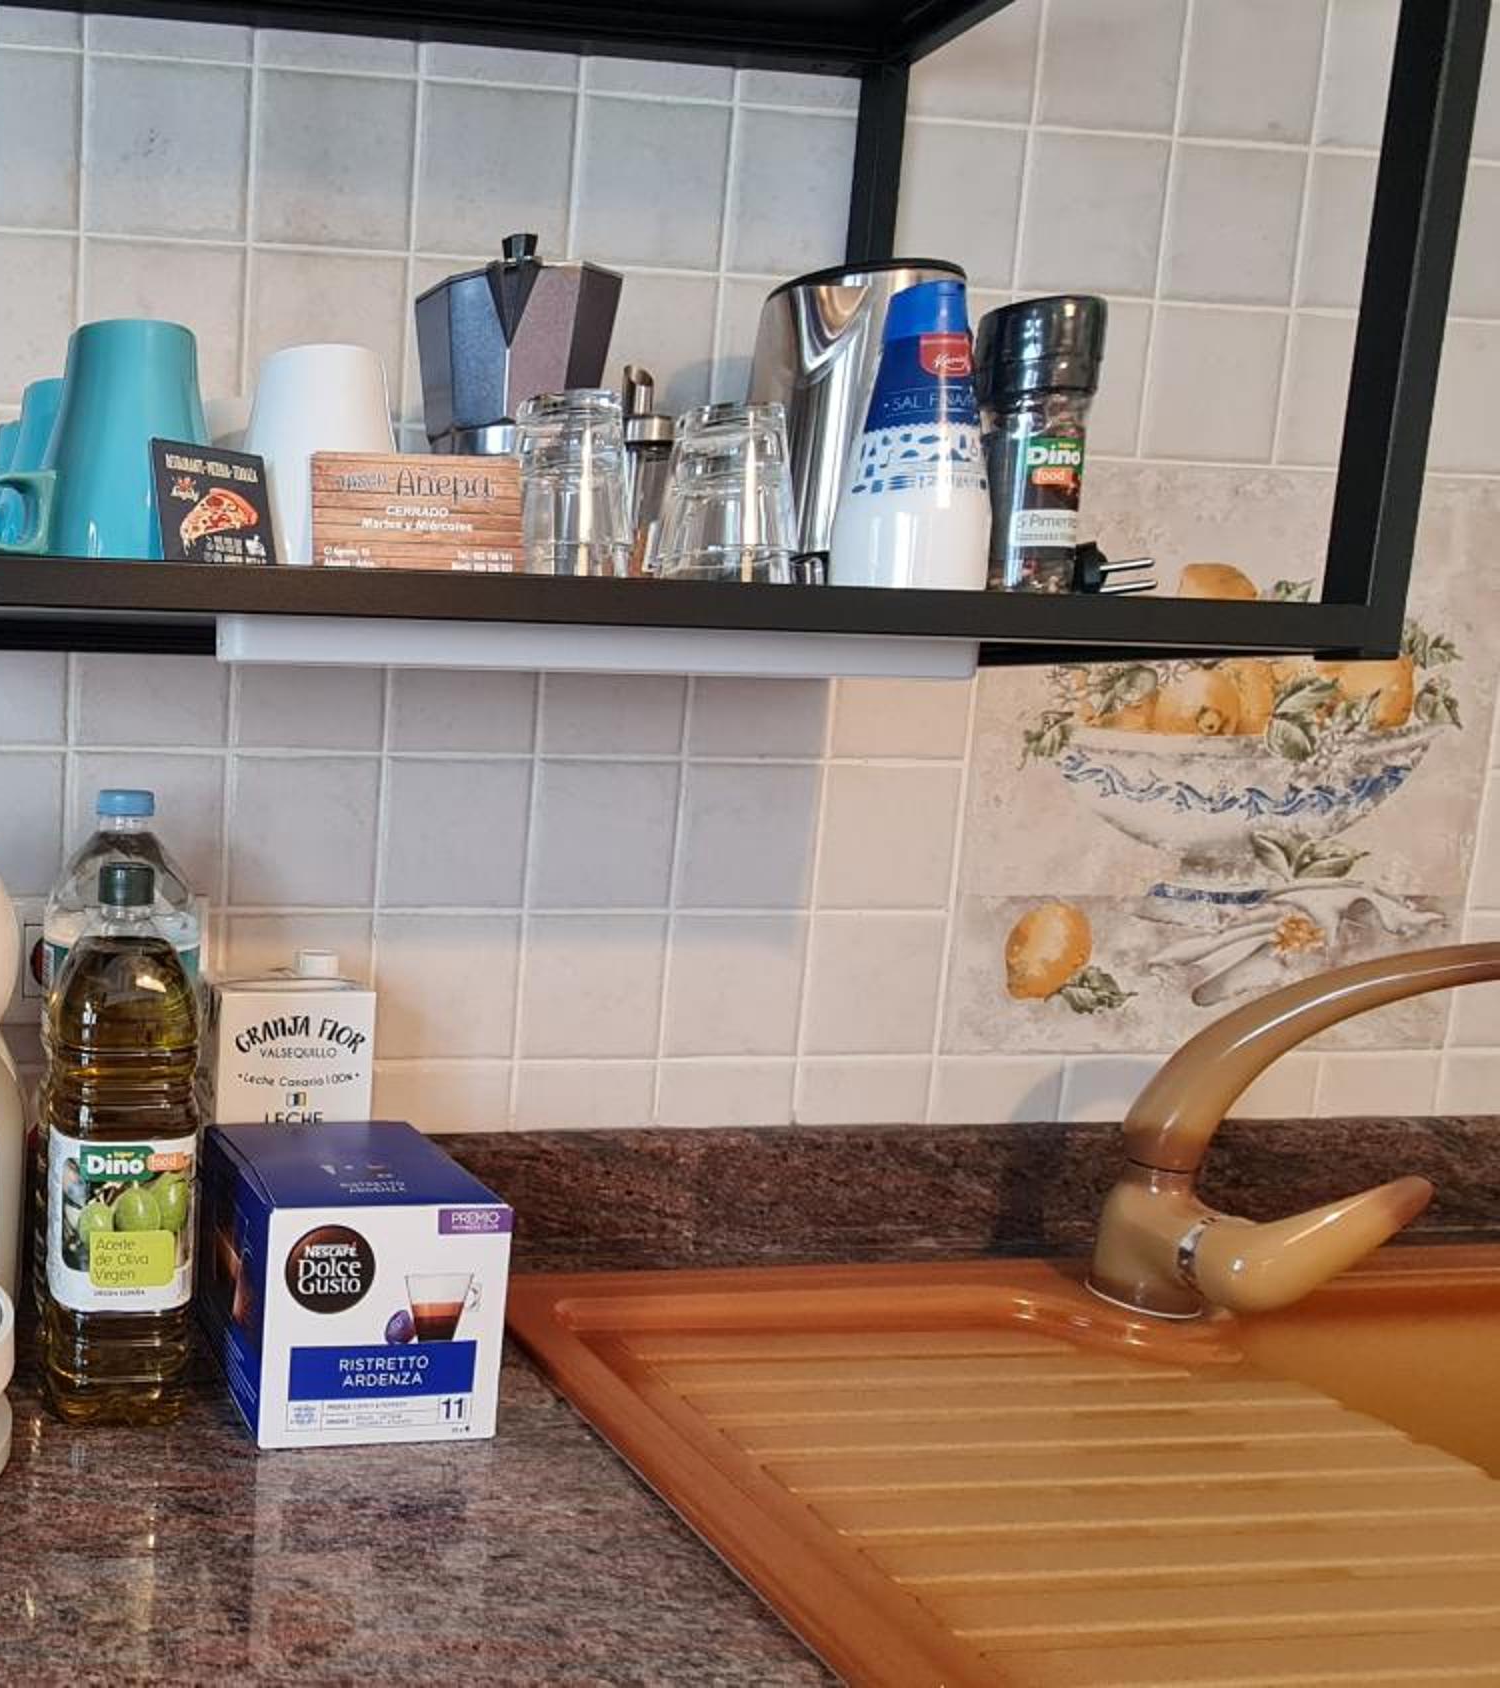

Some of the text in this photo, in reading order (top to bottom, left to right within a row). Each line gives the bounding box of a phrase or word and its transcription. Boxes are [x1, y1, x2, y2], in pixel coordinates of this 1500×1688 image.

[891, 394, 922, 411] SAL
[1027, 444, 1080, 465] Dino
[396, 466, 495, 505] Añepa
[386, 505, 450, 518] CERRADO
[360, 517, 399, 530] Martes
[235, 1015, 310, 1054] GRANJA
[259, 1047, 338, 1059] VALSEQUILLO
[243, 1072, 275, 1087] Leche
[87, 1154, 145, 1175] Dino
[95, 1239, 135, 1251] Aceite
[304, 1243, 357, 1258] NESCAFÉ
[95, 1253, 149, 1266] de Oliva
[298, 1258, 361, 1278] Dolce
[95, 1270, 135, 1283] Virgen
[297, 1277, 361, 1295] Gusto
[339, 1355, 429, 1372] RISTRETTO
[343, 1372, 423, 1387] ARDENZA
[442, 1398, 463, 1419] 11
